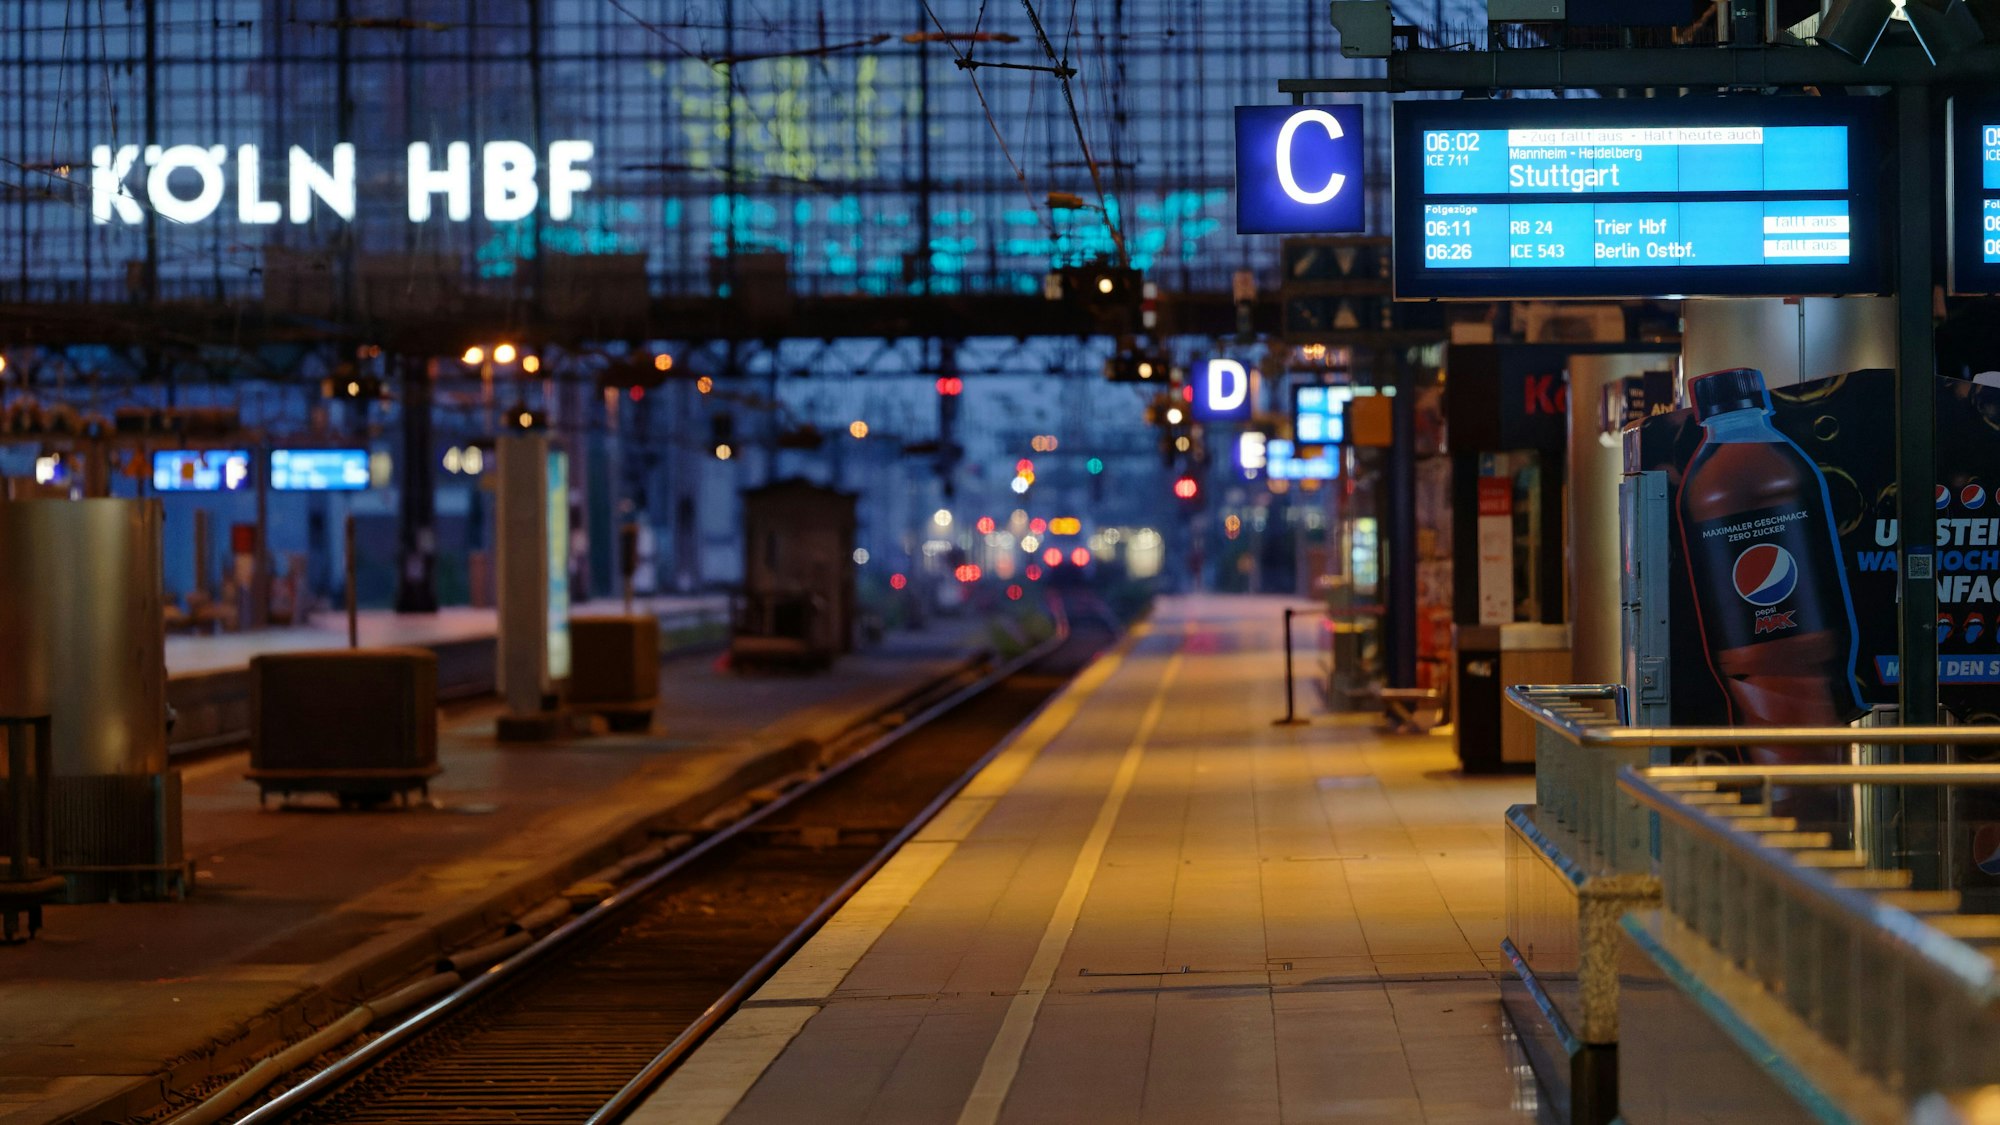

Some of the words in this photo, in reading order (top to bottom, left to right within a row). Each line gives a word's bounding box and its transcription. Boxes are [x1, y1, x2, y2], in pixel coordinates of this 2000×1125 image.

[1426, 133, 1479, 151] 06:02
[1530, 131, 1555, 144] Zug
[1598, 133, 1623, 142] aus
[1644, 130, 1673, 142] Halt
[1679, 130, 1722, 141] heute
[1727, 129, 1761, 141] auch
[1276, 109, 1346, 204] C
[1426, 155, 1445, 166] ICE
[1448, 154, 1469, 166] 711
[1509, 147, 1567, 160] Mannheim
[1578, 147, 1642, 161] Heidelberg
[92, 144, 355, 225] KÖLN
[408, 141, 593, 223] HBF
[1509, 164, 1620, 192] Stuttgart
[1425, 205, 1478, 215] Folgezüge
[1425, 220, 1471, 236] 06:11
[1510, 221, 1530, 235] RB
[1535, 221, 1553, 235] 24
[1595, 219, 1631, 235] Trier
[1639, 219, 1667, 235] Hbf
[1812, 218, 1837, 227] aus
[1425, 244, 1472, 260] 06:26
[1511, 244, 1533, 258] ICE
[1538, 244, 1565, 258] 543
[1595, 243, 1639, 259] Berlin
[1646, 242, 1696, 259] Ostbf.
[1812, 241, 1837, 250] aus
[1208, 359, 1247, 411] D
[1702, 522, 1753, 538] MAXIMALER
[1754, 511, 1808, 527] GESCHMACK
[1728, 531, 1751, 542] ZERO
[1753, 524, 1785, 537] ZUCKER
[1947, 661, 1984, 676] DEN
